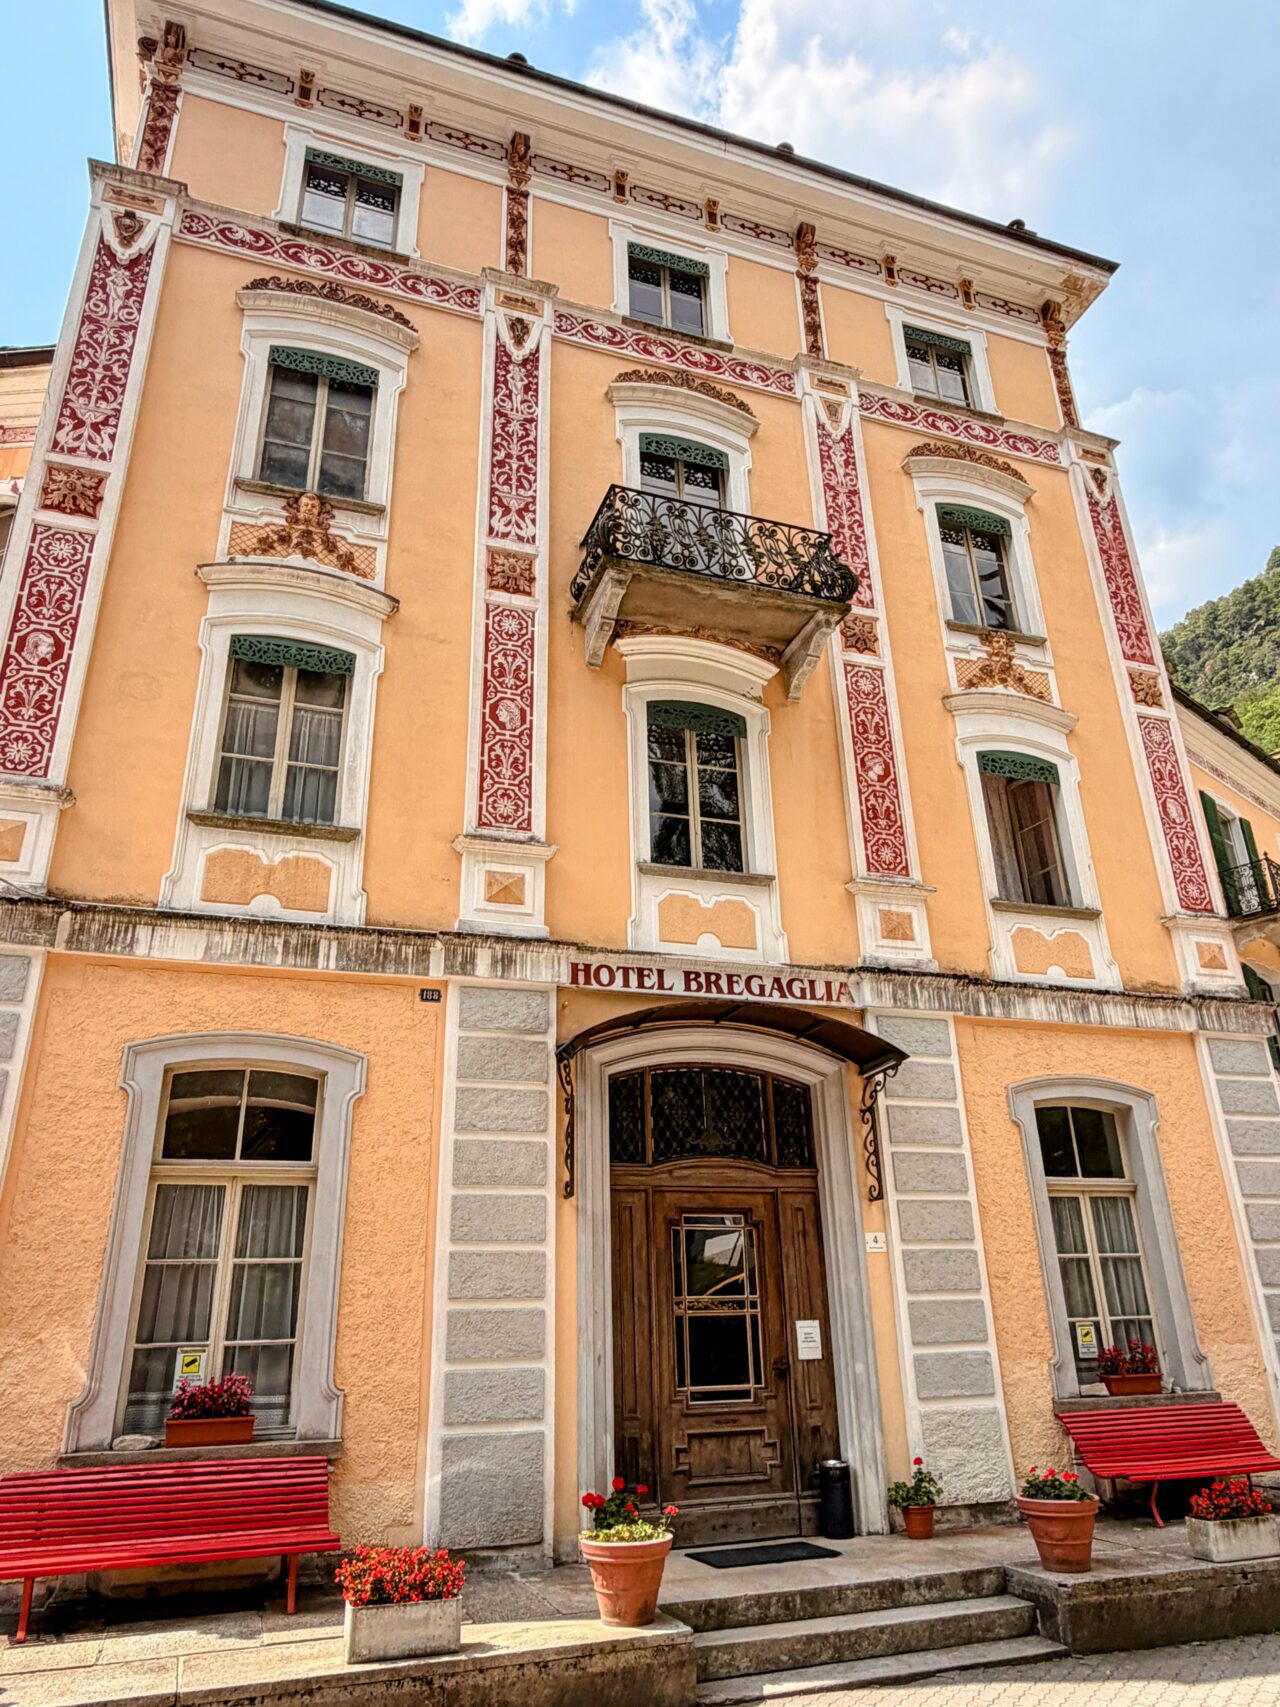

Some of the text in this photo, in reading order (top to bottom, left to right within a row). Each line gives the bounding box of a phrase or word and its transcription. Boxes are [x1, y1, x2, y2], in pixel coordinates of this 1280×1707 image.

[569, 962, 855, 1003] HOTEL BREGAGLIA
[423, 990, 439, 1000] 188
[873, 1235, 878, 1244] 4
